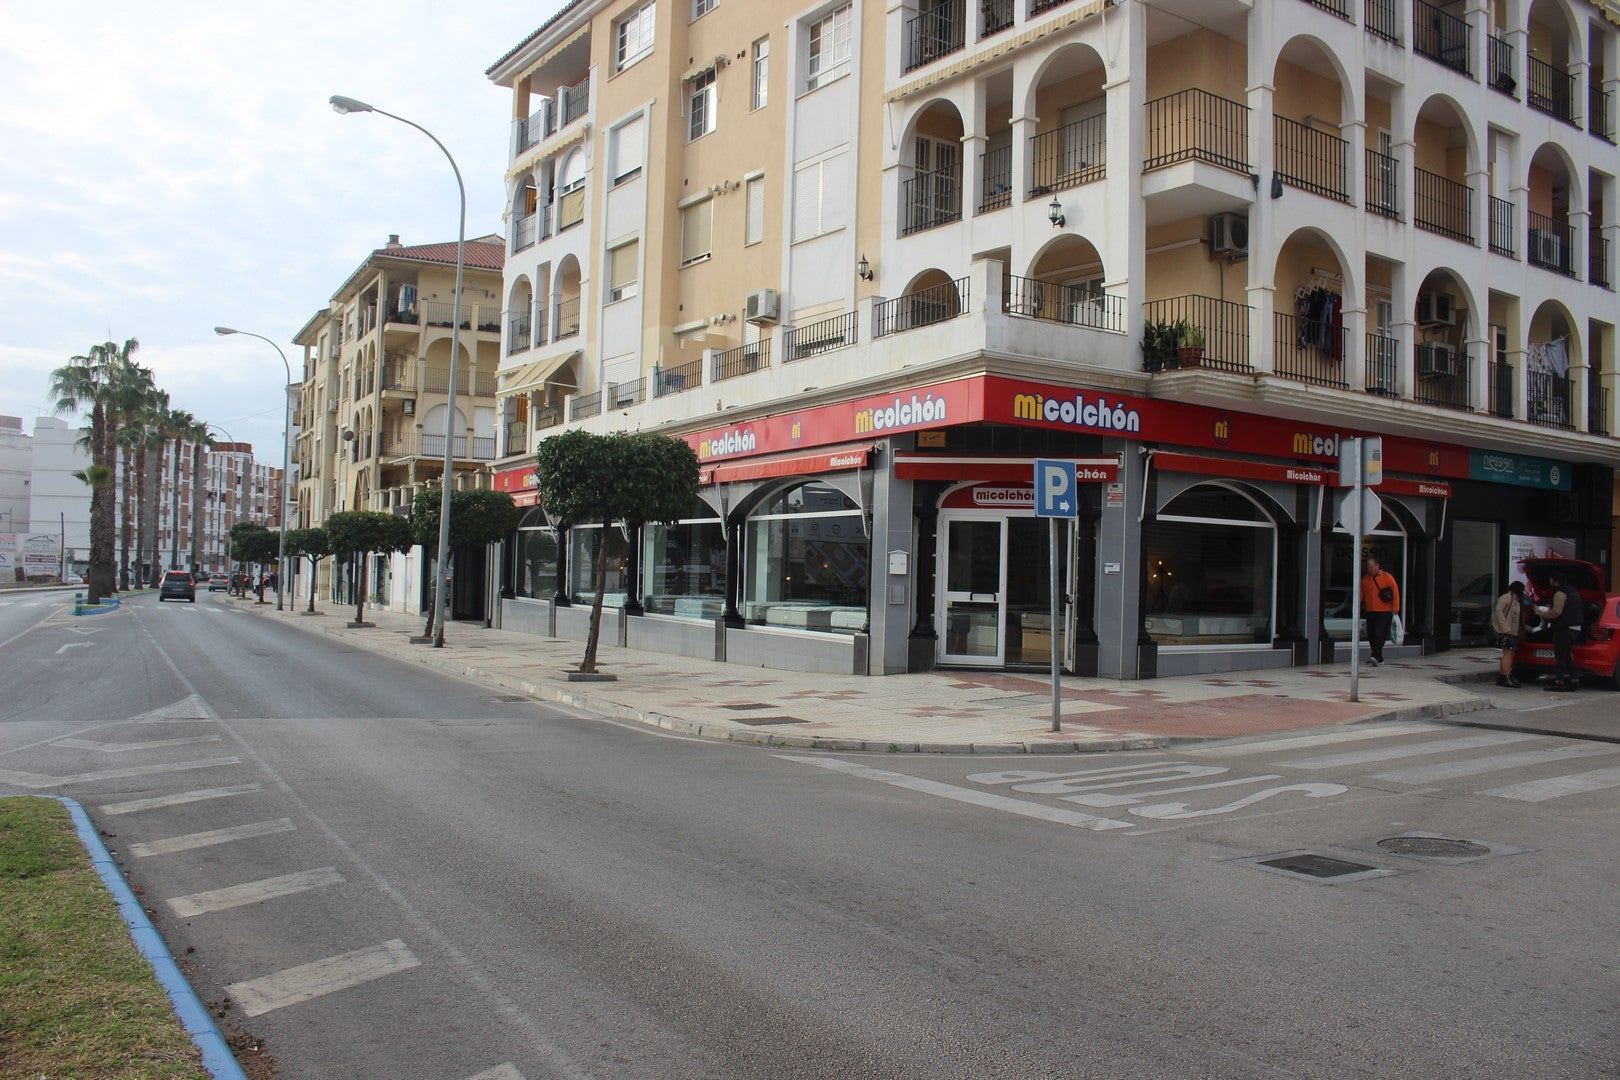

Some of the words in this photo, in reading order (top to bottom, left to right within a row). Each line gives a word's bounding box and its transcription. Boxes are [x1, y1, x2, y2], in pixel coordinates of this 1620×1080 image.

[855, 394, 946, 434] micolchón
[1013, 394, 1140, 432] micolchón
[699, 429, 755, 458] micolchón
[1293, 432, 1340, 456] micol
[1045, 466, 1069, 510] P
